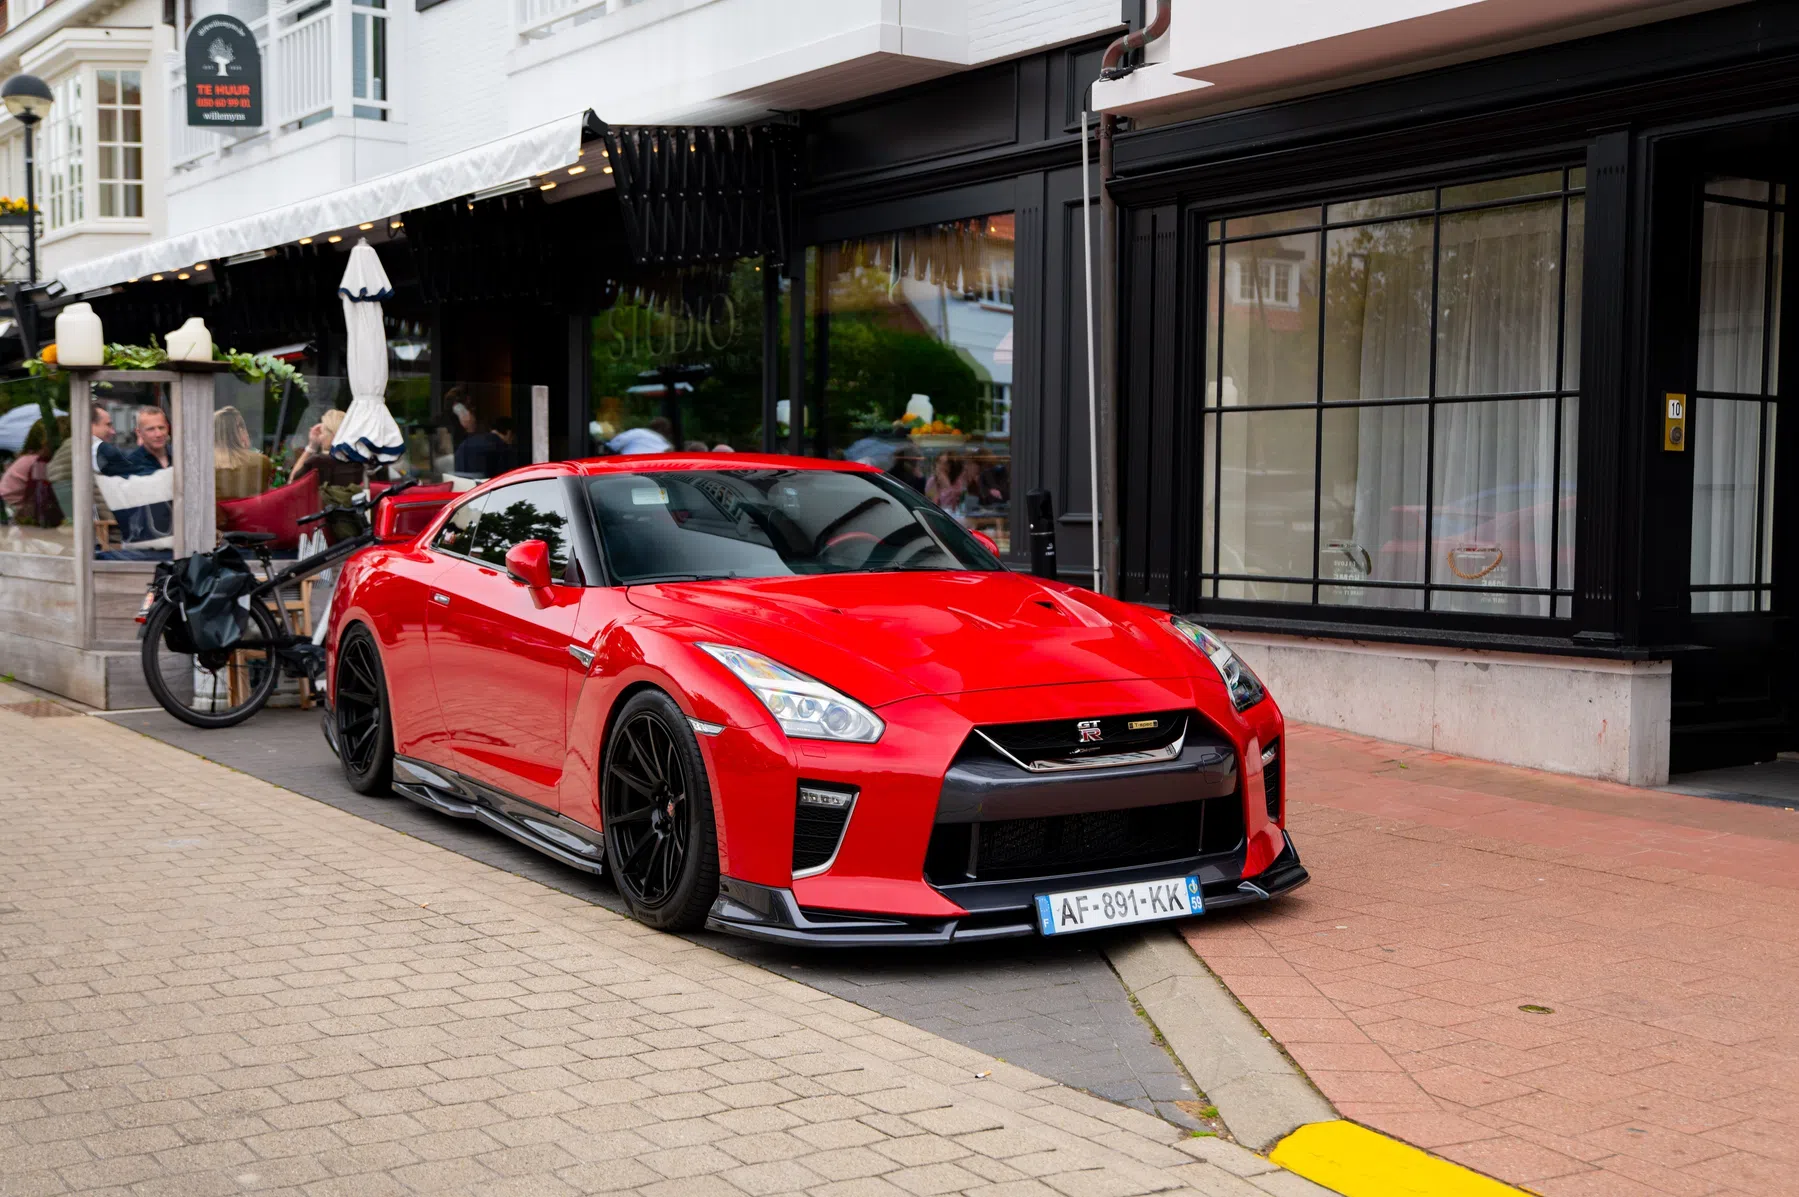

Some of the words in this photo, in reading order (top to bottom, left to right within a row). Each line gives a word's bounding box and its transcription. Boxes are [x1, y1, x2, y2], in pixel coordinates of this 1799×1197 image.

[196, 84, 213, 95] TE
[215, 84, 250, 96] HUUR
[202, 111, 246, 122] willemyns
[607, 293, 735, 361] STUDIO
[1671, 402, 1681, 416] 10
[1077, 720, 1101, 729] GT
[1079, 728, 1103, 742] R
[1061, 883, 1185, 926] AF-891-KK
[1191, 896, 1203, 909] 59
[1043, 918, 1049, 927] F
